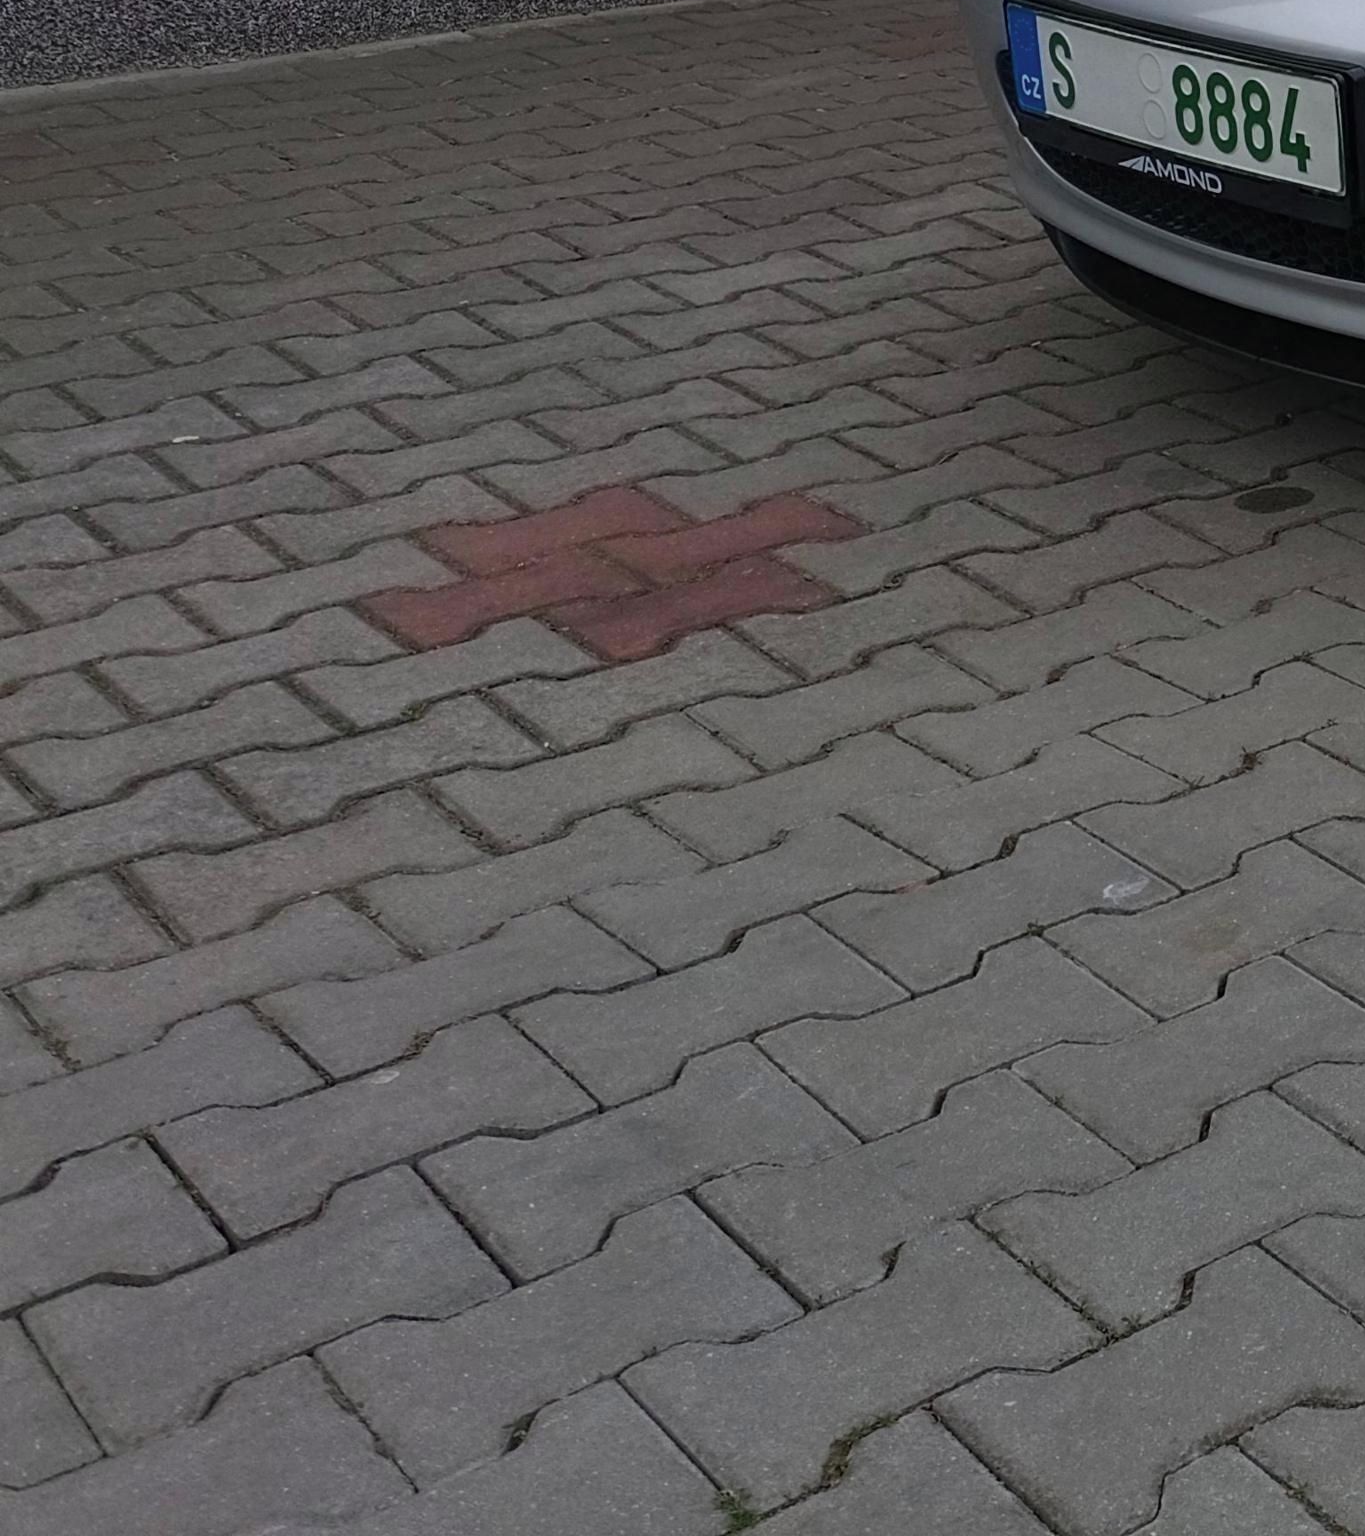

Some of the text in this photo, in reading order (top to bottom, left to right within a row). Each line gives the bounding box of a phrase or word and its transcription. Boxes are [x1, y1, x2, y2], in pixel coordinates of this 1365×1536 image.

[1021, 73, 1042, 99] CZ
[1048, 31, 1310, 173] S 8884
